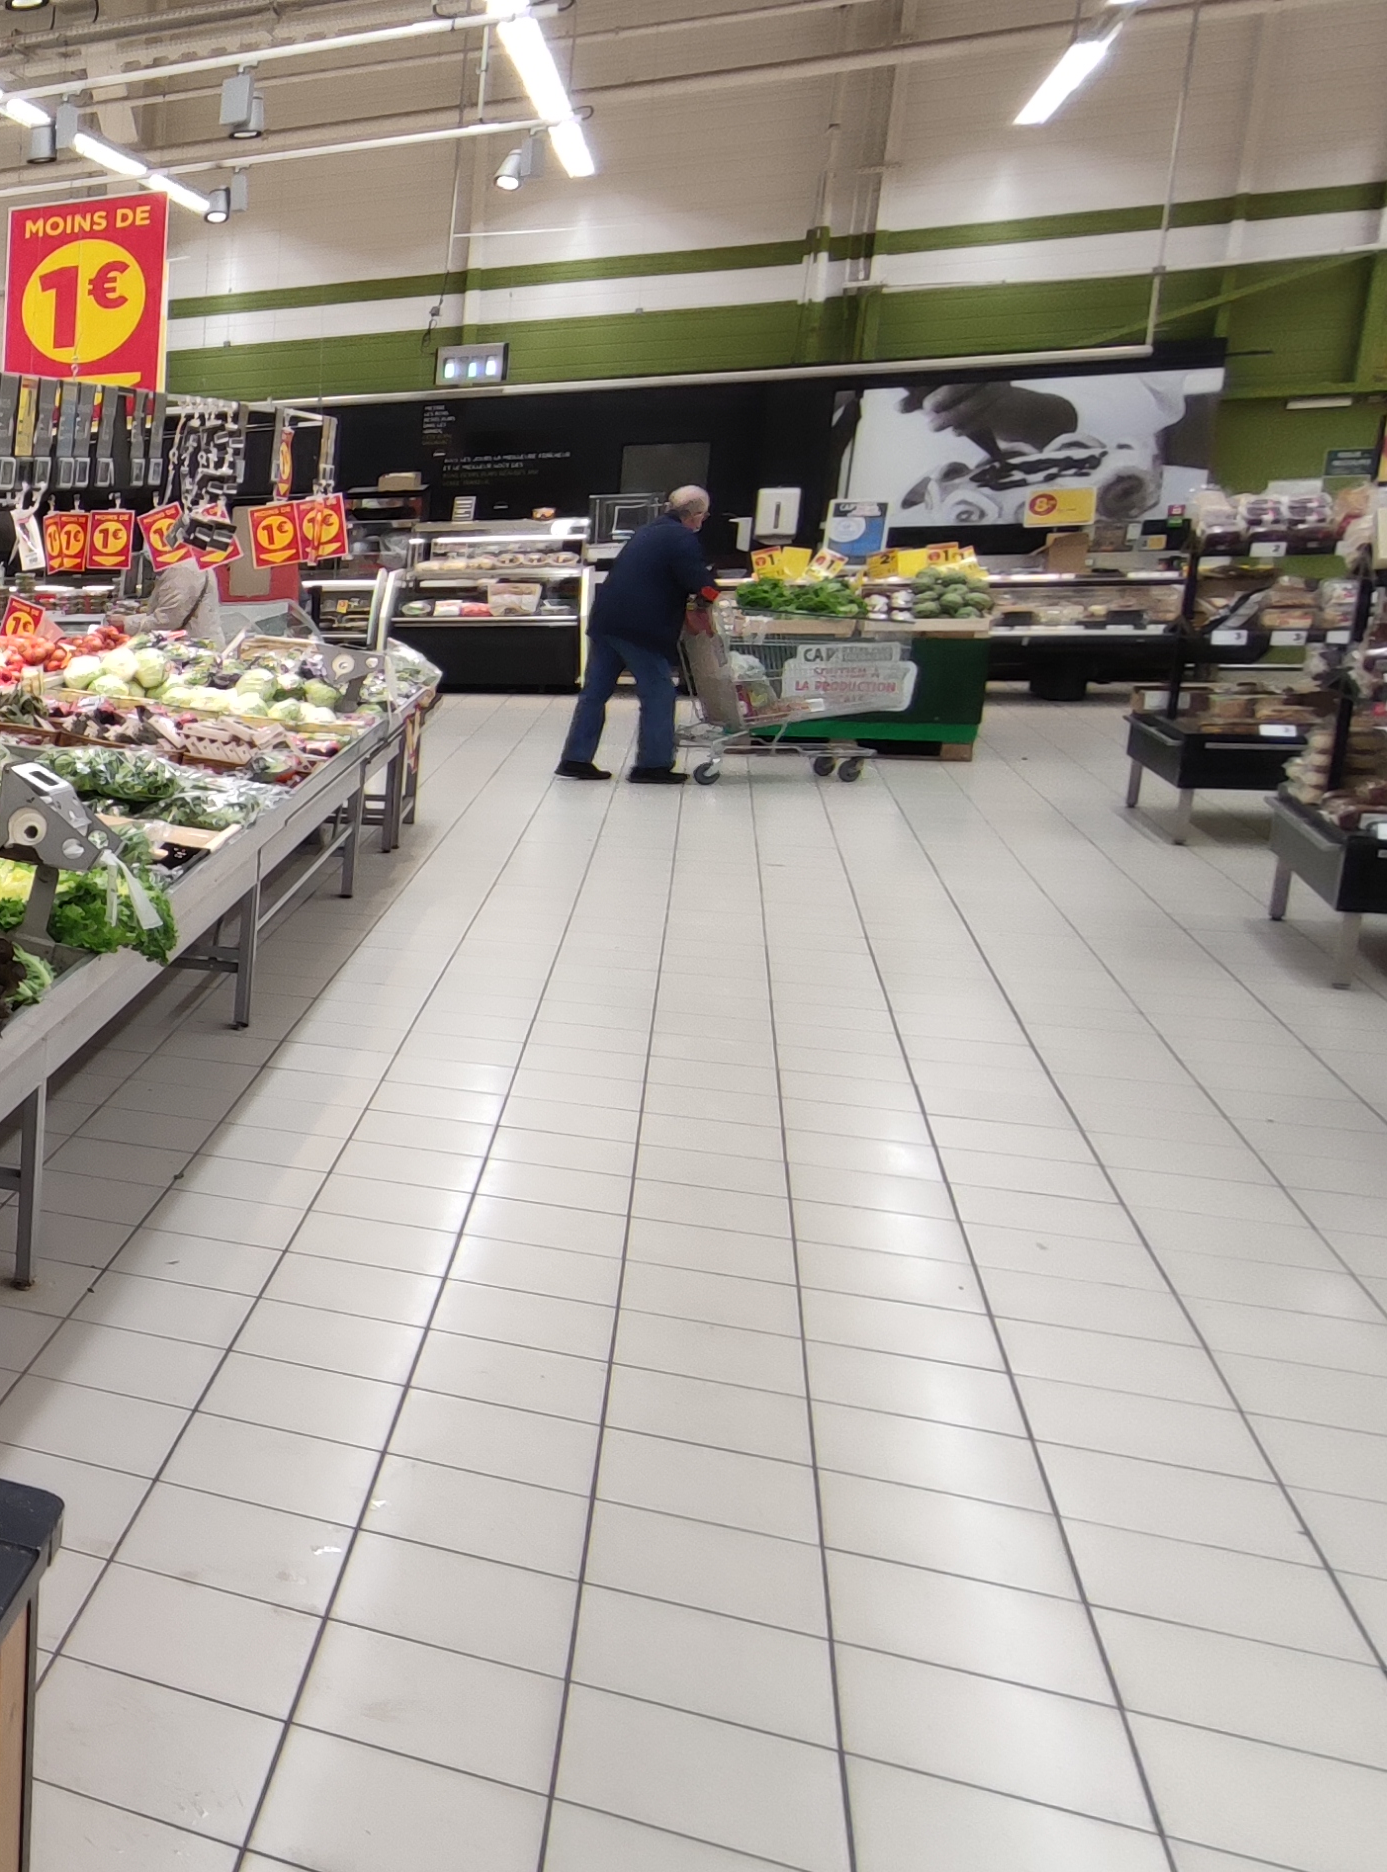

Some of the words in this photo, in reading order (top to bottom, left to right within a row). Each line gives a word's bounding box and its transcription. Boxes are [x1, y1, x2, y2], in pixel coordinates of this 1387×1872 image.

[25, 210, 107, 239] MOINS
[115, 205, 151, 229] DE
[39, 260, 131, 350] 1€
[98, 527, 124, 549] 1€
[261, 520, 289, 546] 1€
[795, 681, 809, 691] LA
[815, 681, 897, 692] PRODUCTION
